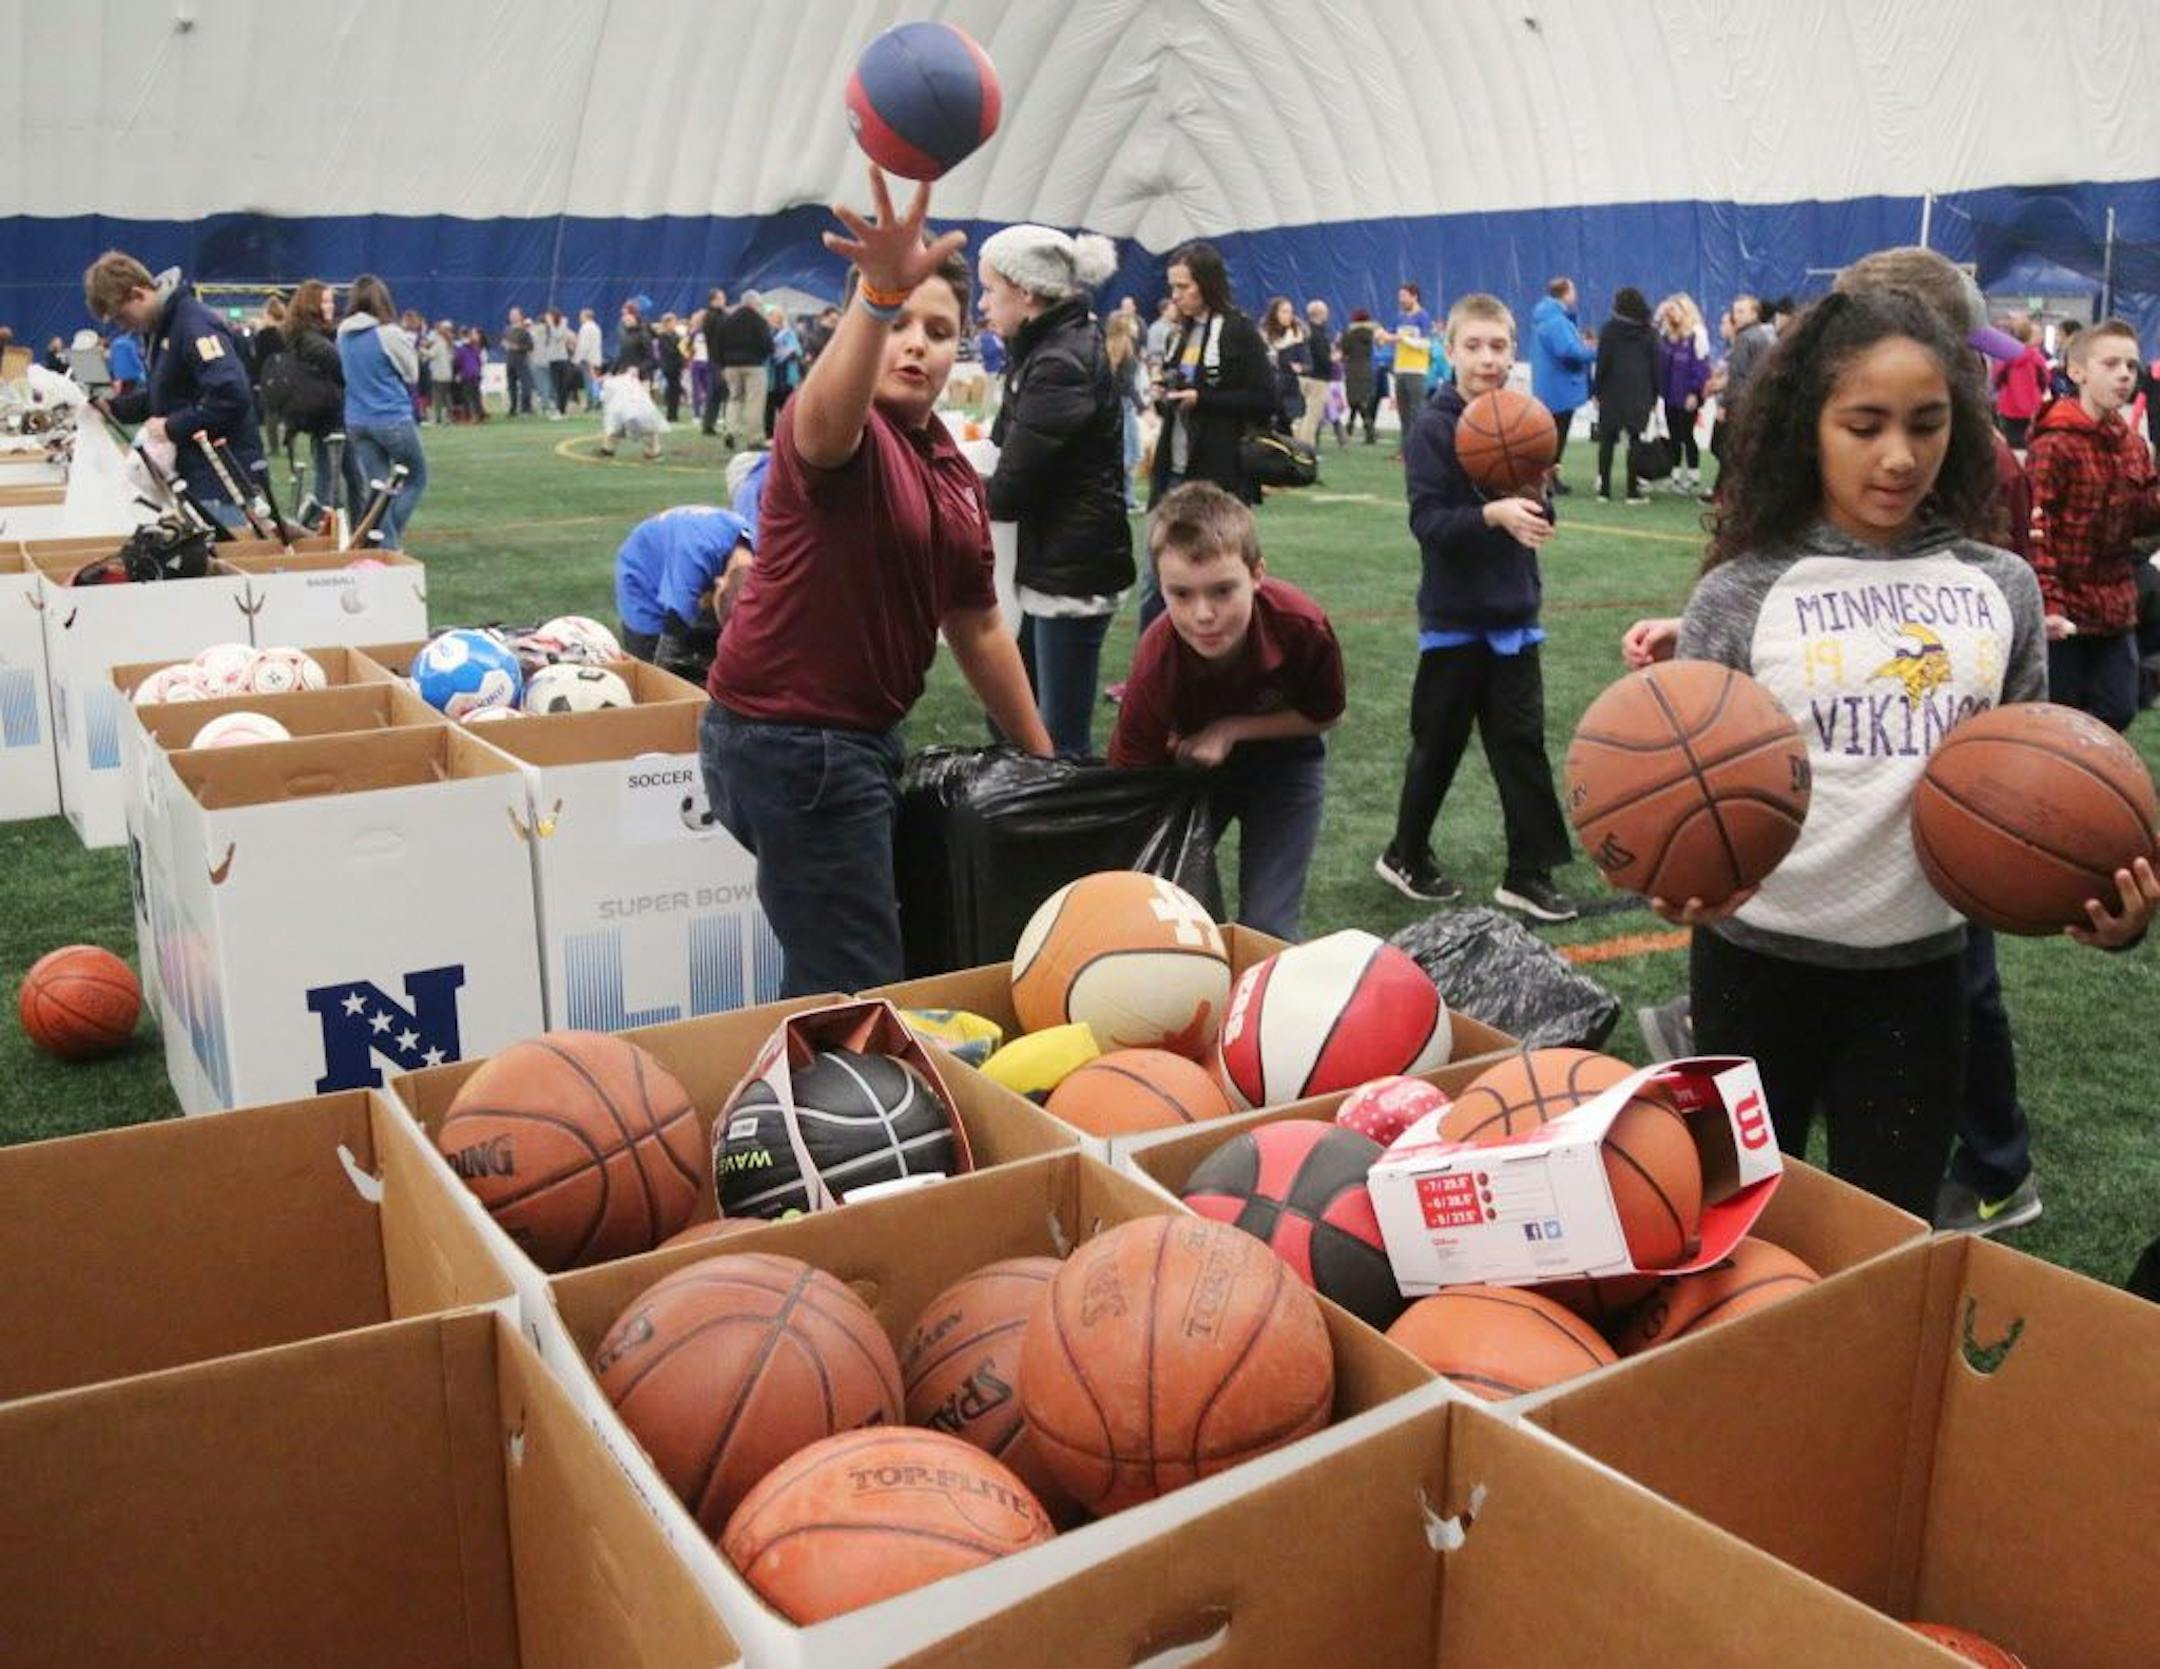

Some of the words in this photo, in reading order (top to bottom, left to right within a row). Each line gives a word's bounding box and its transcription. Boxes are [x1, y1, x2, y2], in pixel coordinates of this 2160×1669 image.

[1794, 583, 1995, 636] MINNESOTA
[1803, 640, 1844, 688] 19
[628, 769, 694, 789] SOCCER
[599, 891, 690, 920] SUPER
[697, 884, 755, 907] BOW
